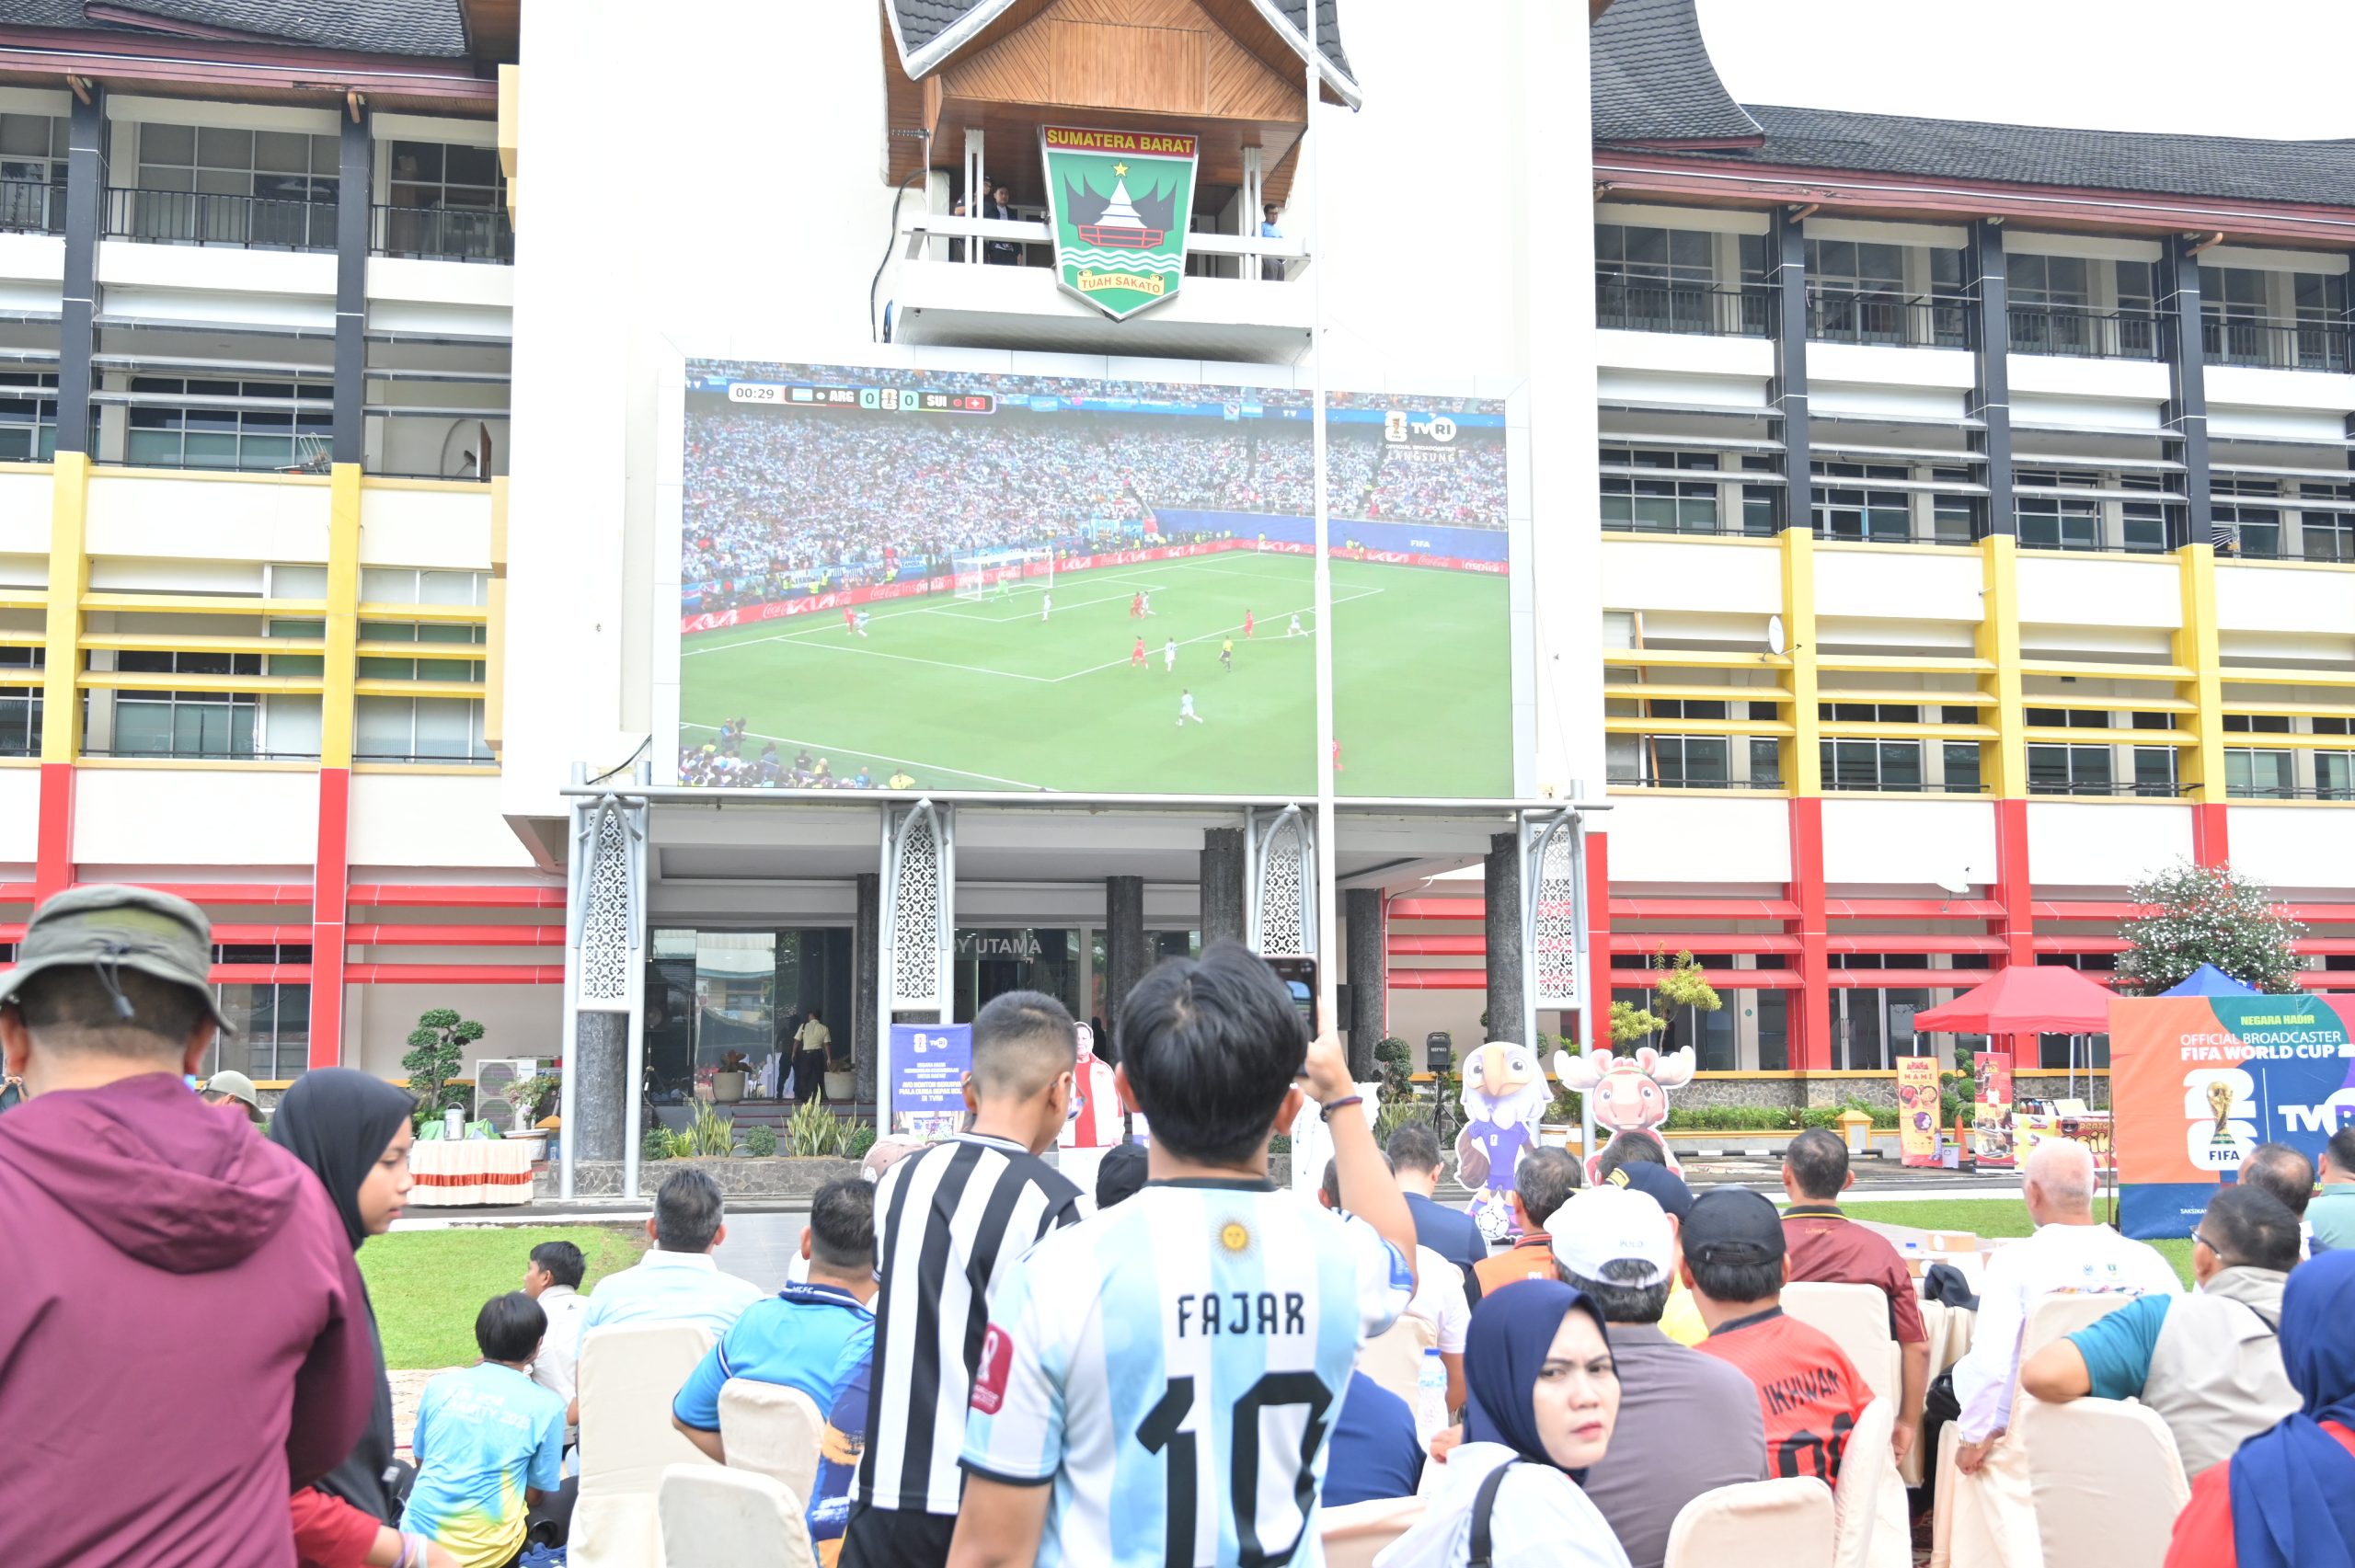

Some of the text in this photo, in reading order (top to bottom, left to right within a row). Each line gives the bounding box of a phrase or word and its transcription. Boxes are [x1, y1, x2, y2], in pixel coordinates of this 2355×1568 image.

[1047, 129, 1193, 153] SUMATERA BARAT
[1082, 276, 1161, 293] TUAH SAKATO
[735, 386, 948, 407] 00:29 ARG 0 0 SUI
[1387, 452, 1455, 463] LANGSUNG
[1410, 540, 1430, 548] FIFA
[954, 938, 1042, 954] Y UTAMA
[2240, 1014, 2315, 1025] NEGARA HADIR
[2180, 1031, 2341, 1046] OFFICIAL BROADCASTER
[2180, 1047, 2223, 1061] FIFA
[2223, 1046, 2293, 1059] WORLD
[2296, 1045, 2334, 1059] CUP
[2209, 1150, 2240, 1161] FIFA
[1178, 1291, 1304, 1338] FAJAR
[1763, 1368, 1841, 1415] IKHWAN
[1135, 1370, 1334, 1568] 10
